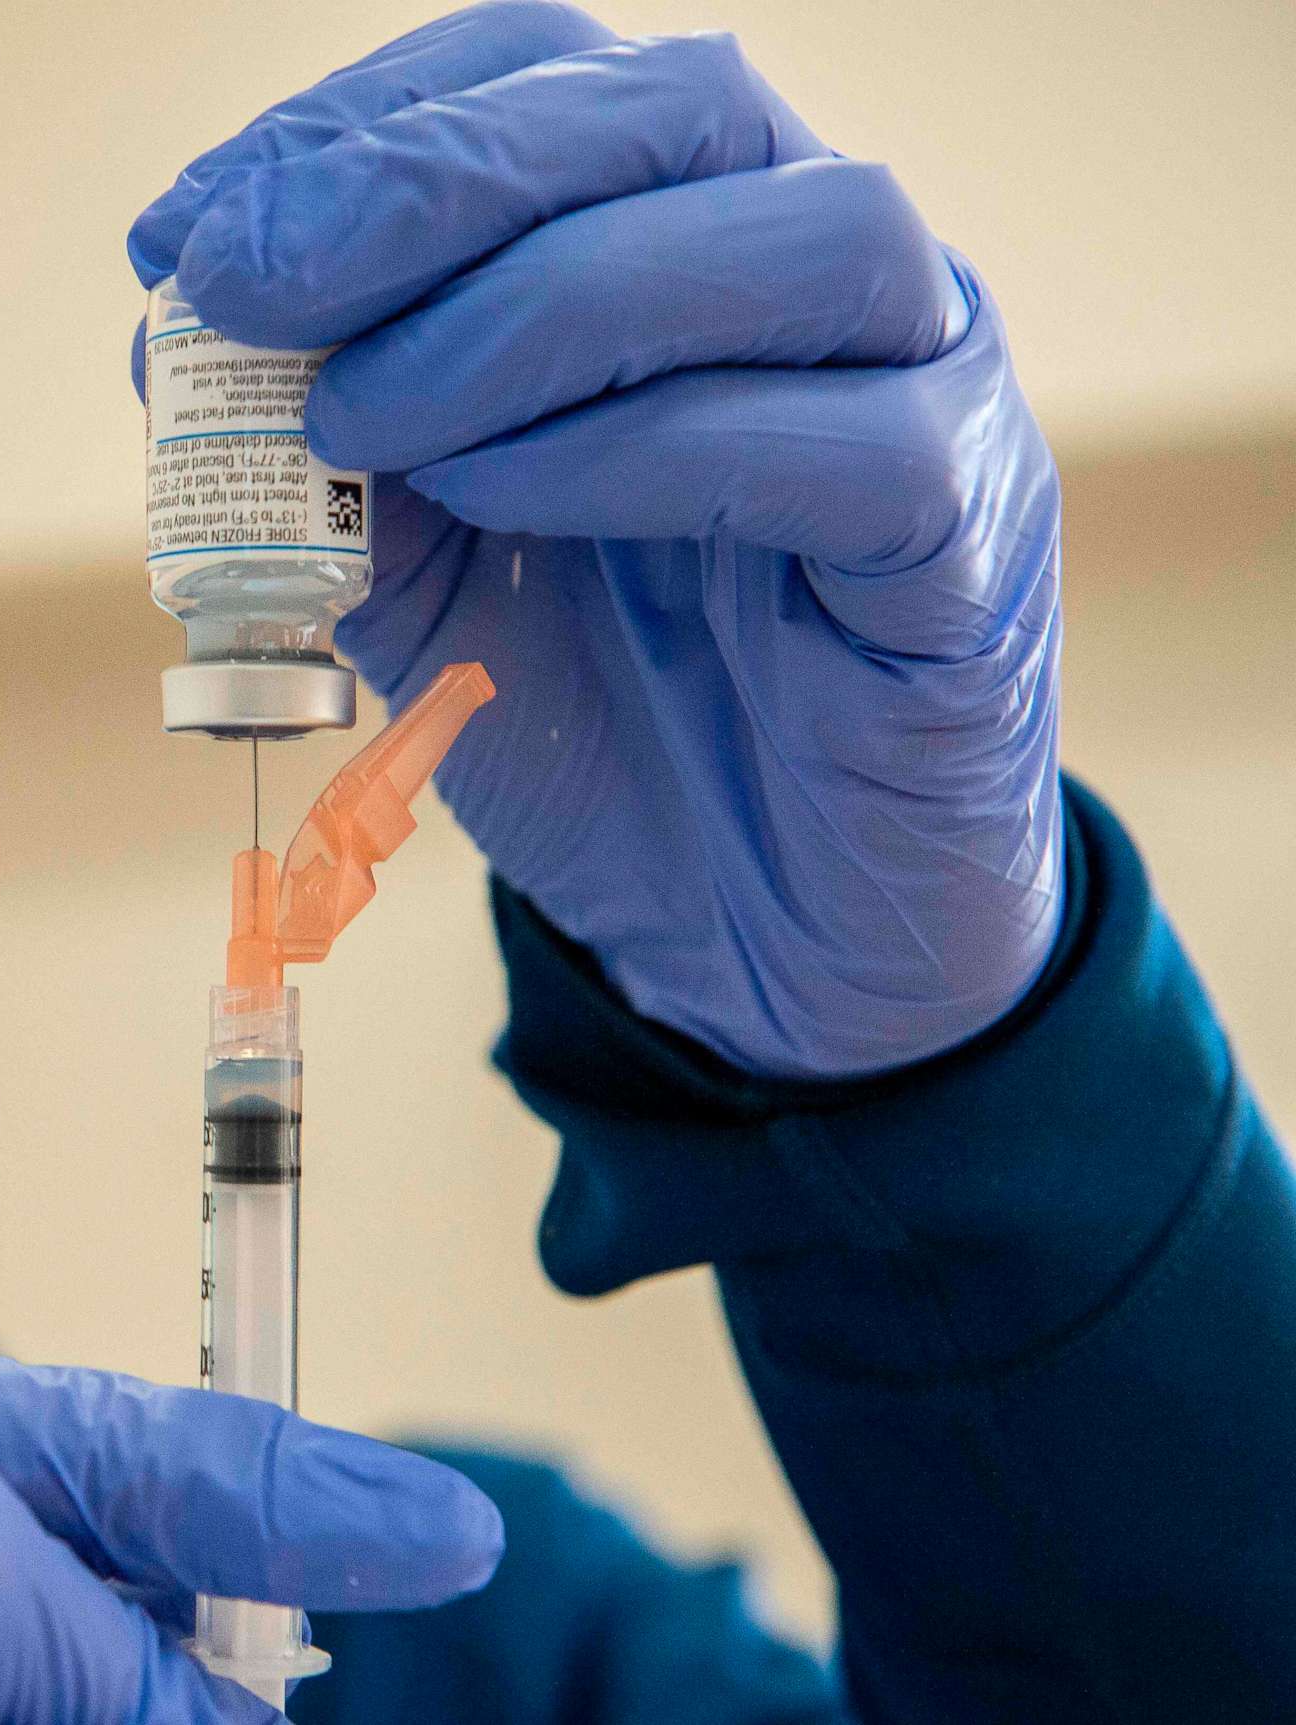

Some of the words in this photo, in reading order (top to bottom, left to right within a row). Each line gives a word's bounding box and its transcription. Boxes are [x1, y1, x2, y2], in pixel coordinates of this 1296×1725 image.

[174, 335, 188, 349] MA
[189, 331, 225, 344] bridge,
[170, 358, 321, 382] atx.com/covid19vaccine-eua/
[192, 378, 212, 392] visit
[216, 376, 226, 386] or
[229, 374, 264, 387] dates,
[267, 374, 317, 386] xpiration
[222, 389, 305, 402] administration,
[175, 409, 199, 424] Sheet
[203, 408, 224, 420] Fact
[228, 405, 305, 419] DA-authorized
[171, 441, 188, 455] first
[191, 439, 201, 453] of
[204, 435, 261, 450] date/time
[265, 435, 308, 450] Record
[162, 462, 168, 475] 6
[170, 460, 189, 473] after
[192, 454, 234, 470] Discard
[183, 476, 193, 488] at
[195, 473, 219, 488] hold
[223, 470, 248, 483] use,
[252, 471, 275, 485] first
[279, 471, 308, 485] After
[182, 494, 194, 507] No
[199, 490, 227, 504] light.
[231, 490, 260, 503] from
[264, 490, 308, 503] Protect
[175, 513, 200, 528] ready
[202, 512, 227, 526] until
[232, 509, 258, 524] 5°F)
[261, 510, 273, 523] to
[275, 509, 308, 524] (-13°
[162, 518, 172, 531] for
[167, 530, 208, 545] between
[211, 528, 261, 543] FROZEN
[265, 528, 308, 542] STORE
